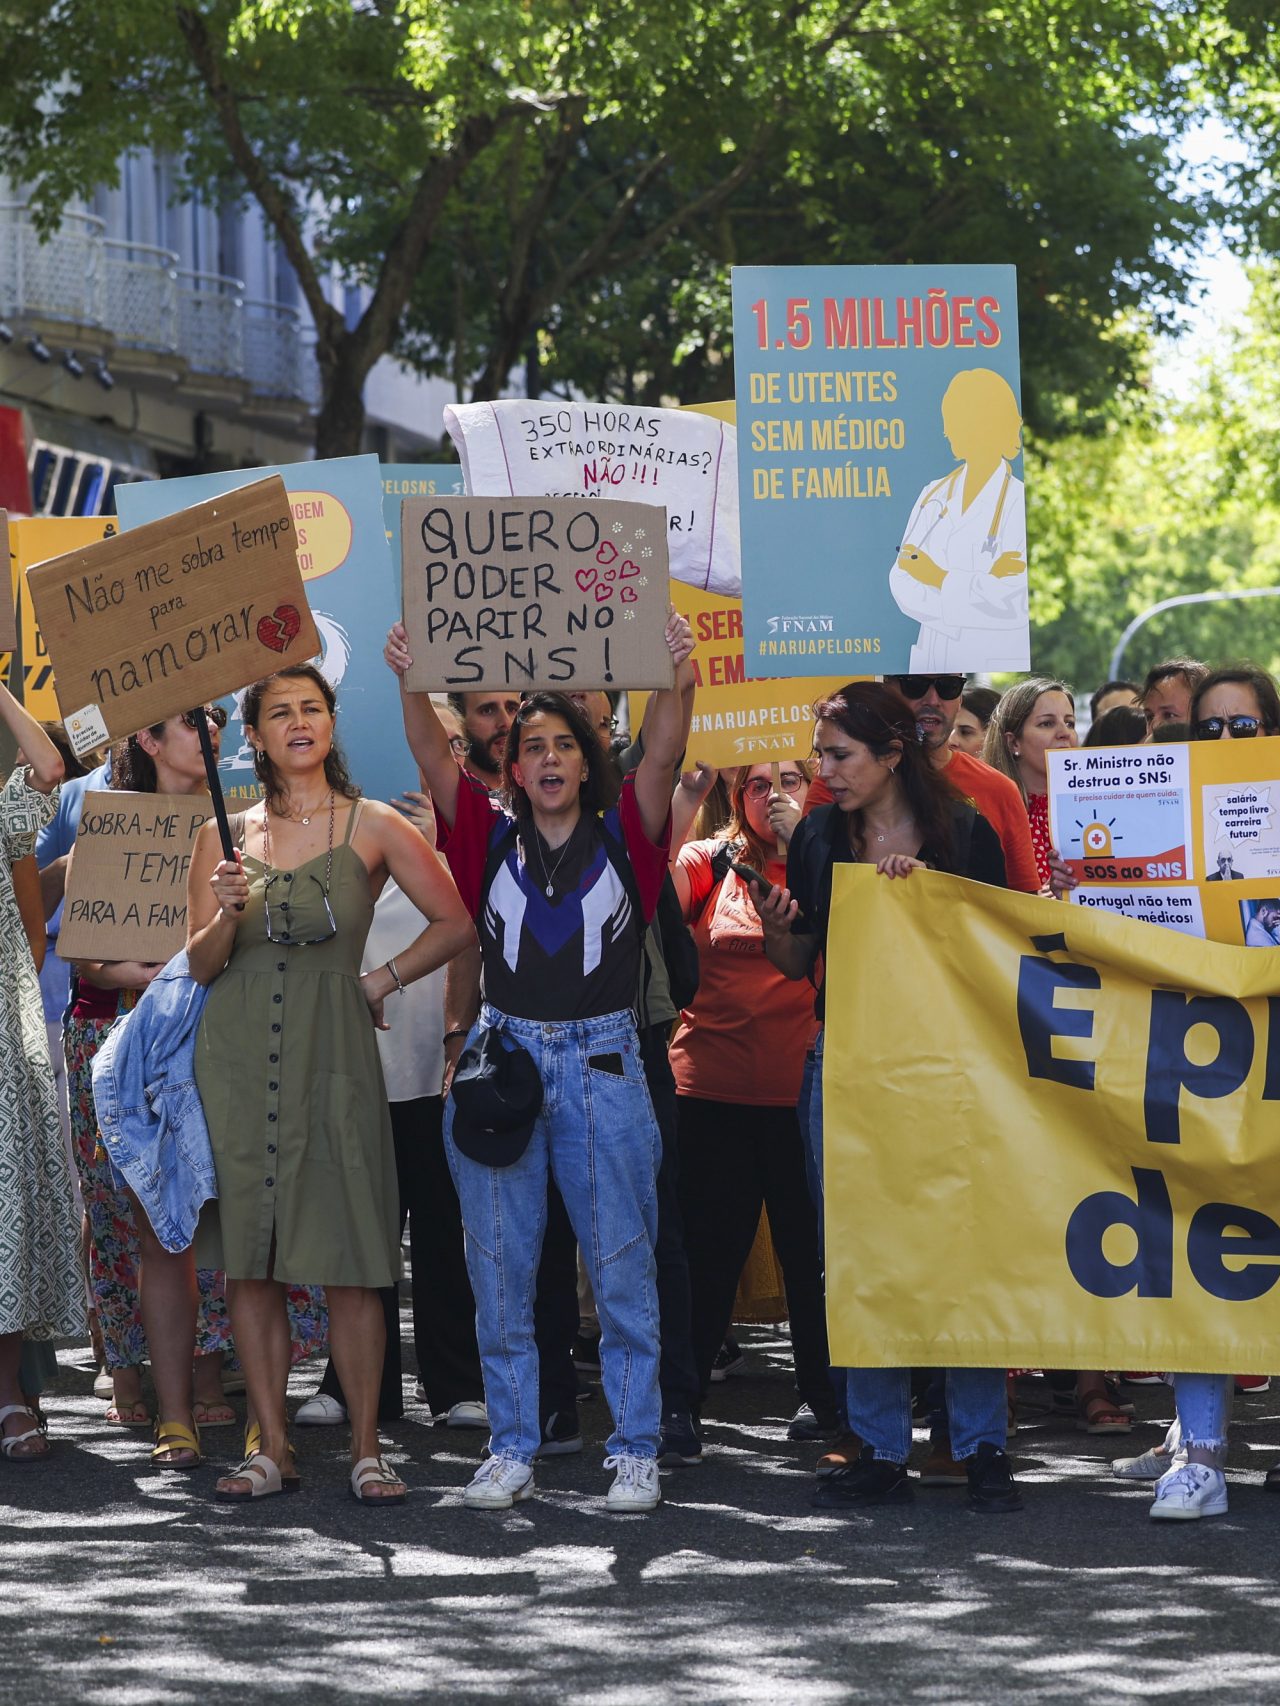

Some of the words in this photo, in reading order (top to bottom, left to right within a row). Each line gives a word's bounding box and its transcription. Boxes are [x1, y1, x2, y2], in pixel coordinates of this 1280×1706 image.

[751, 298, 812, 350] 1.5
[823, 288, 1001, 349] MILHÕES
[750, 373, 782, 404] DE
[789, 371, 898, 403] UTENTES
[521, 410, 571, 442] 350
[584, 411, 662, 437] HORAS
[751, 420, 804, 452] SEM
[811, 414, 905, 450] MÉDICO
[530, 440, 712, 474] EXTRAORDINÁRIAS?
[753, 468, 785, 499] DE
[792, 461, 892, 498] FAMÍLIA
[421, 507, 600, 560] QUERO
[64, 574, 125, 623] Não
[135, 560, 173, 593] me
[182, 537, 225, 575] sobra
[232, 514, 290, 554] tempo
[426, 561, 563, 602] PODER
[150, 595, 187, 631] para
[427, 603, 546, 643] PARIR
[567, 603, 614, 635] NO
[783, 620, 834, 632] FNAM
[90, 604, 254, 702] namorar
[759, 638, 881, 656] #NARUAPELOSNS
[692, 704, 814, 733] #NARUAPELOS
[748, 735, 796, 752] FNAM
[1064, 759, 1081, 771] Sr.
[1086, 756, 1142, 770] Ministro
[1148, 754, 1174, 766] não
[1068, 776, 1120, 788] destrua
[1125, 776, 1134, 785] o
[1139, 771, 1171, 784] SNS!
[1079, 792, 1102, 802] preciso
[1136, 792, 1156, 800] quem
[1157, 790, 1179, 798] cuida.
[1227, 794, 1257, 804] salário
[78, 811, 180, 838] SOBRA-ME
[1219, 808, 1248, 817] tempo
[1249, 806, 1269, 814] livre
[1225, 817, 1261, 827] carreira
[1230, 830, 1258, 839] futuro
[123, 852, 191, 886] TEMP
[1084, 865, 1117, 879] SOS
[1120, 866, 1143, 878] ao
[1146, 862, 1182, 878] SNS
[69, 899, 115, 925] PARA
[122, 902, 140, 927] A
[147, 903, 187, 927] FAM
[1078, 894, 1135, 909] Portugal
[1138, 896, 1162, 906] não
[1167, 896, 1192, 906] tem
[1138, 911, 1193, 923] médicos!
[1016, 933, 1102, 1091] É
